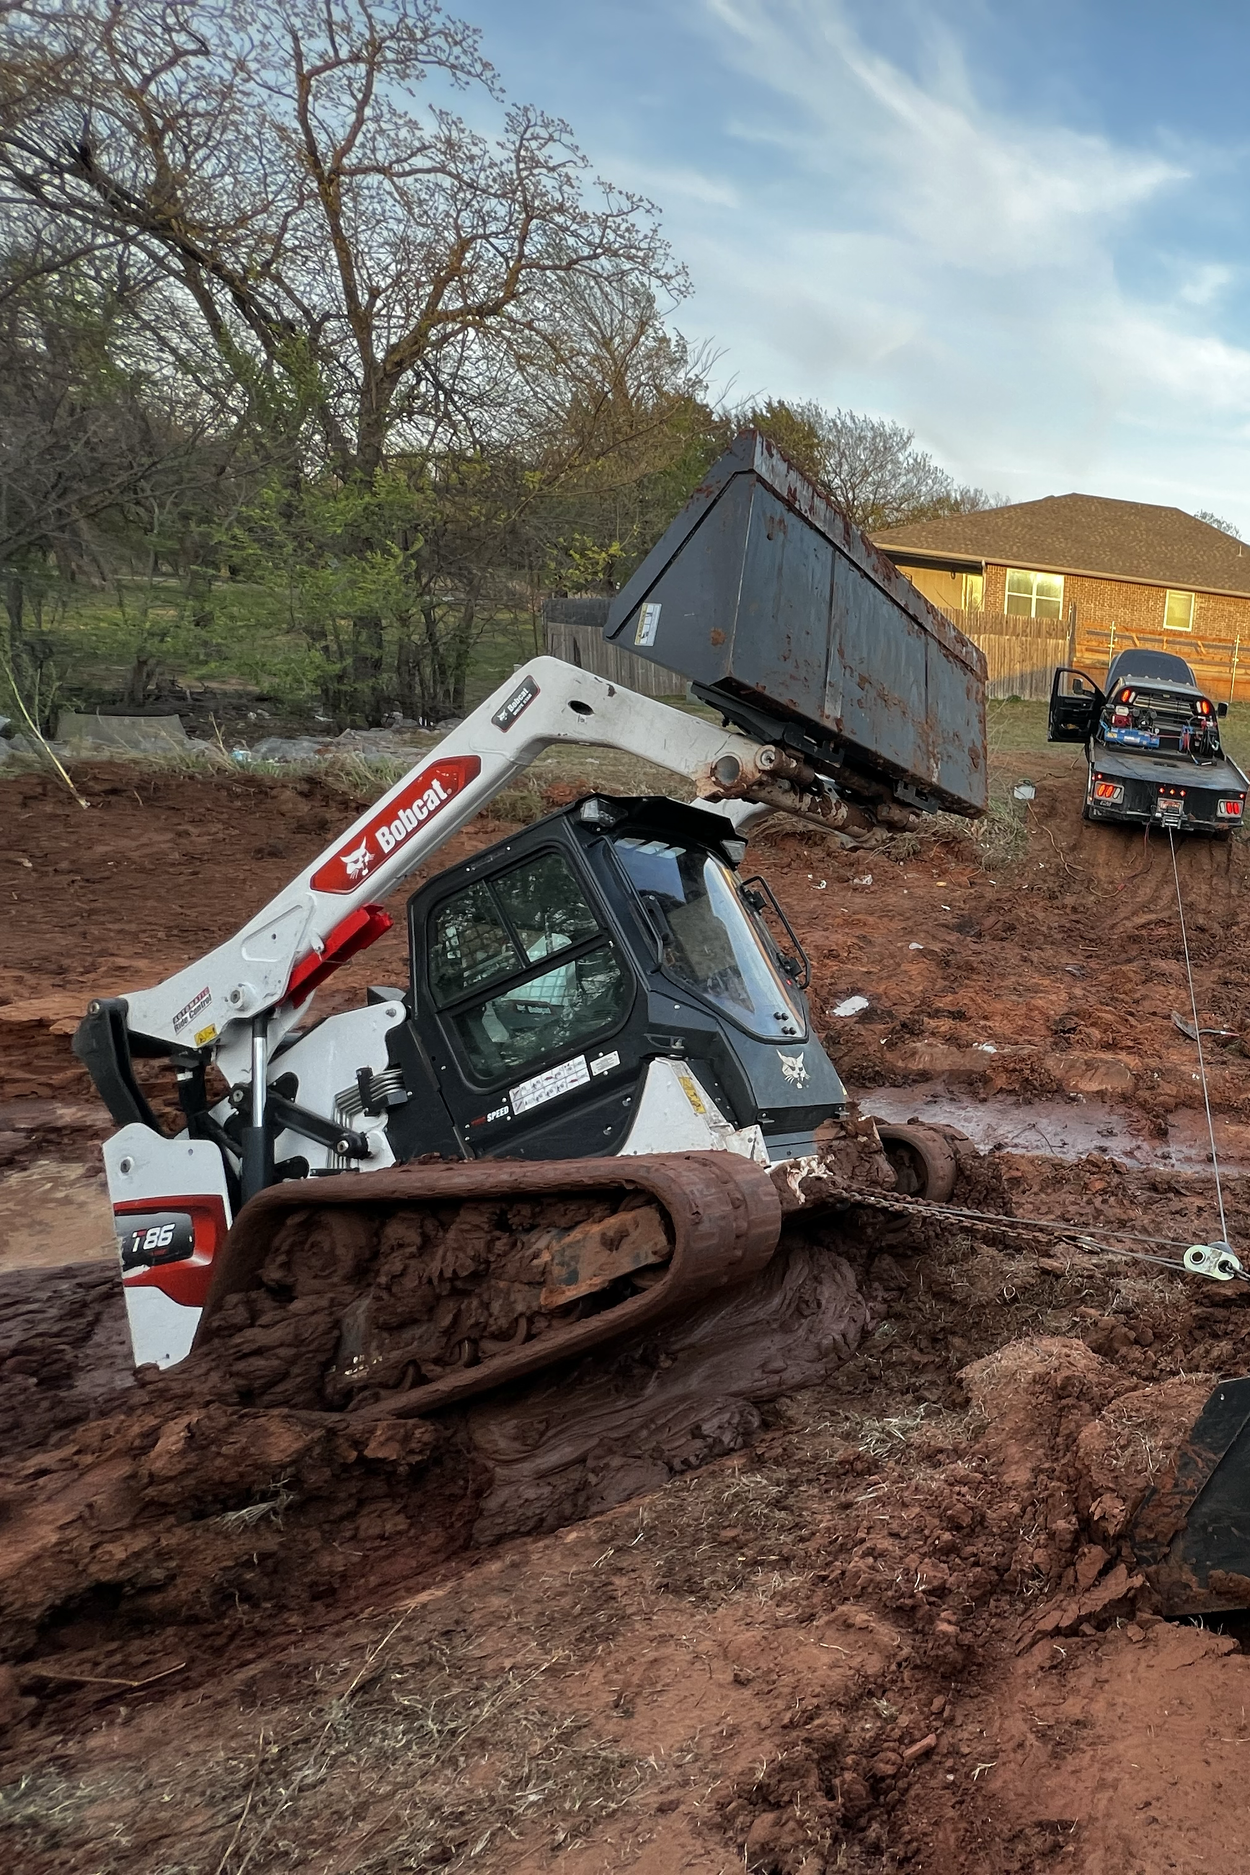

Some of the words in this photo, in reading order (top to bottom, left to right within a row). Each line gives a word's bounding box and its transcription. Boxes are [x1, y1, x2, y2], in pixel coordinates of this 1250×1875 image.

[507, 687, 529, 713] Bobcat
[375, 778, 448, 854] Bobcat
[172, 986, 210, 1025] AUTOMATIC
[174, 1016, 189, 1033] Ride
[189, 993, 212, 1019] Control
[486, 1105, 510, 1123] SPEED
[131, 1222, 176, 1252] T86
